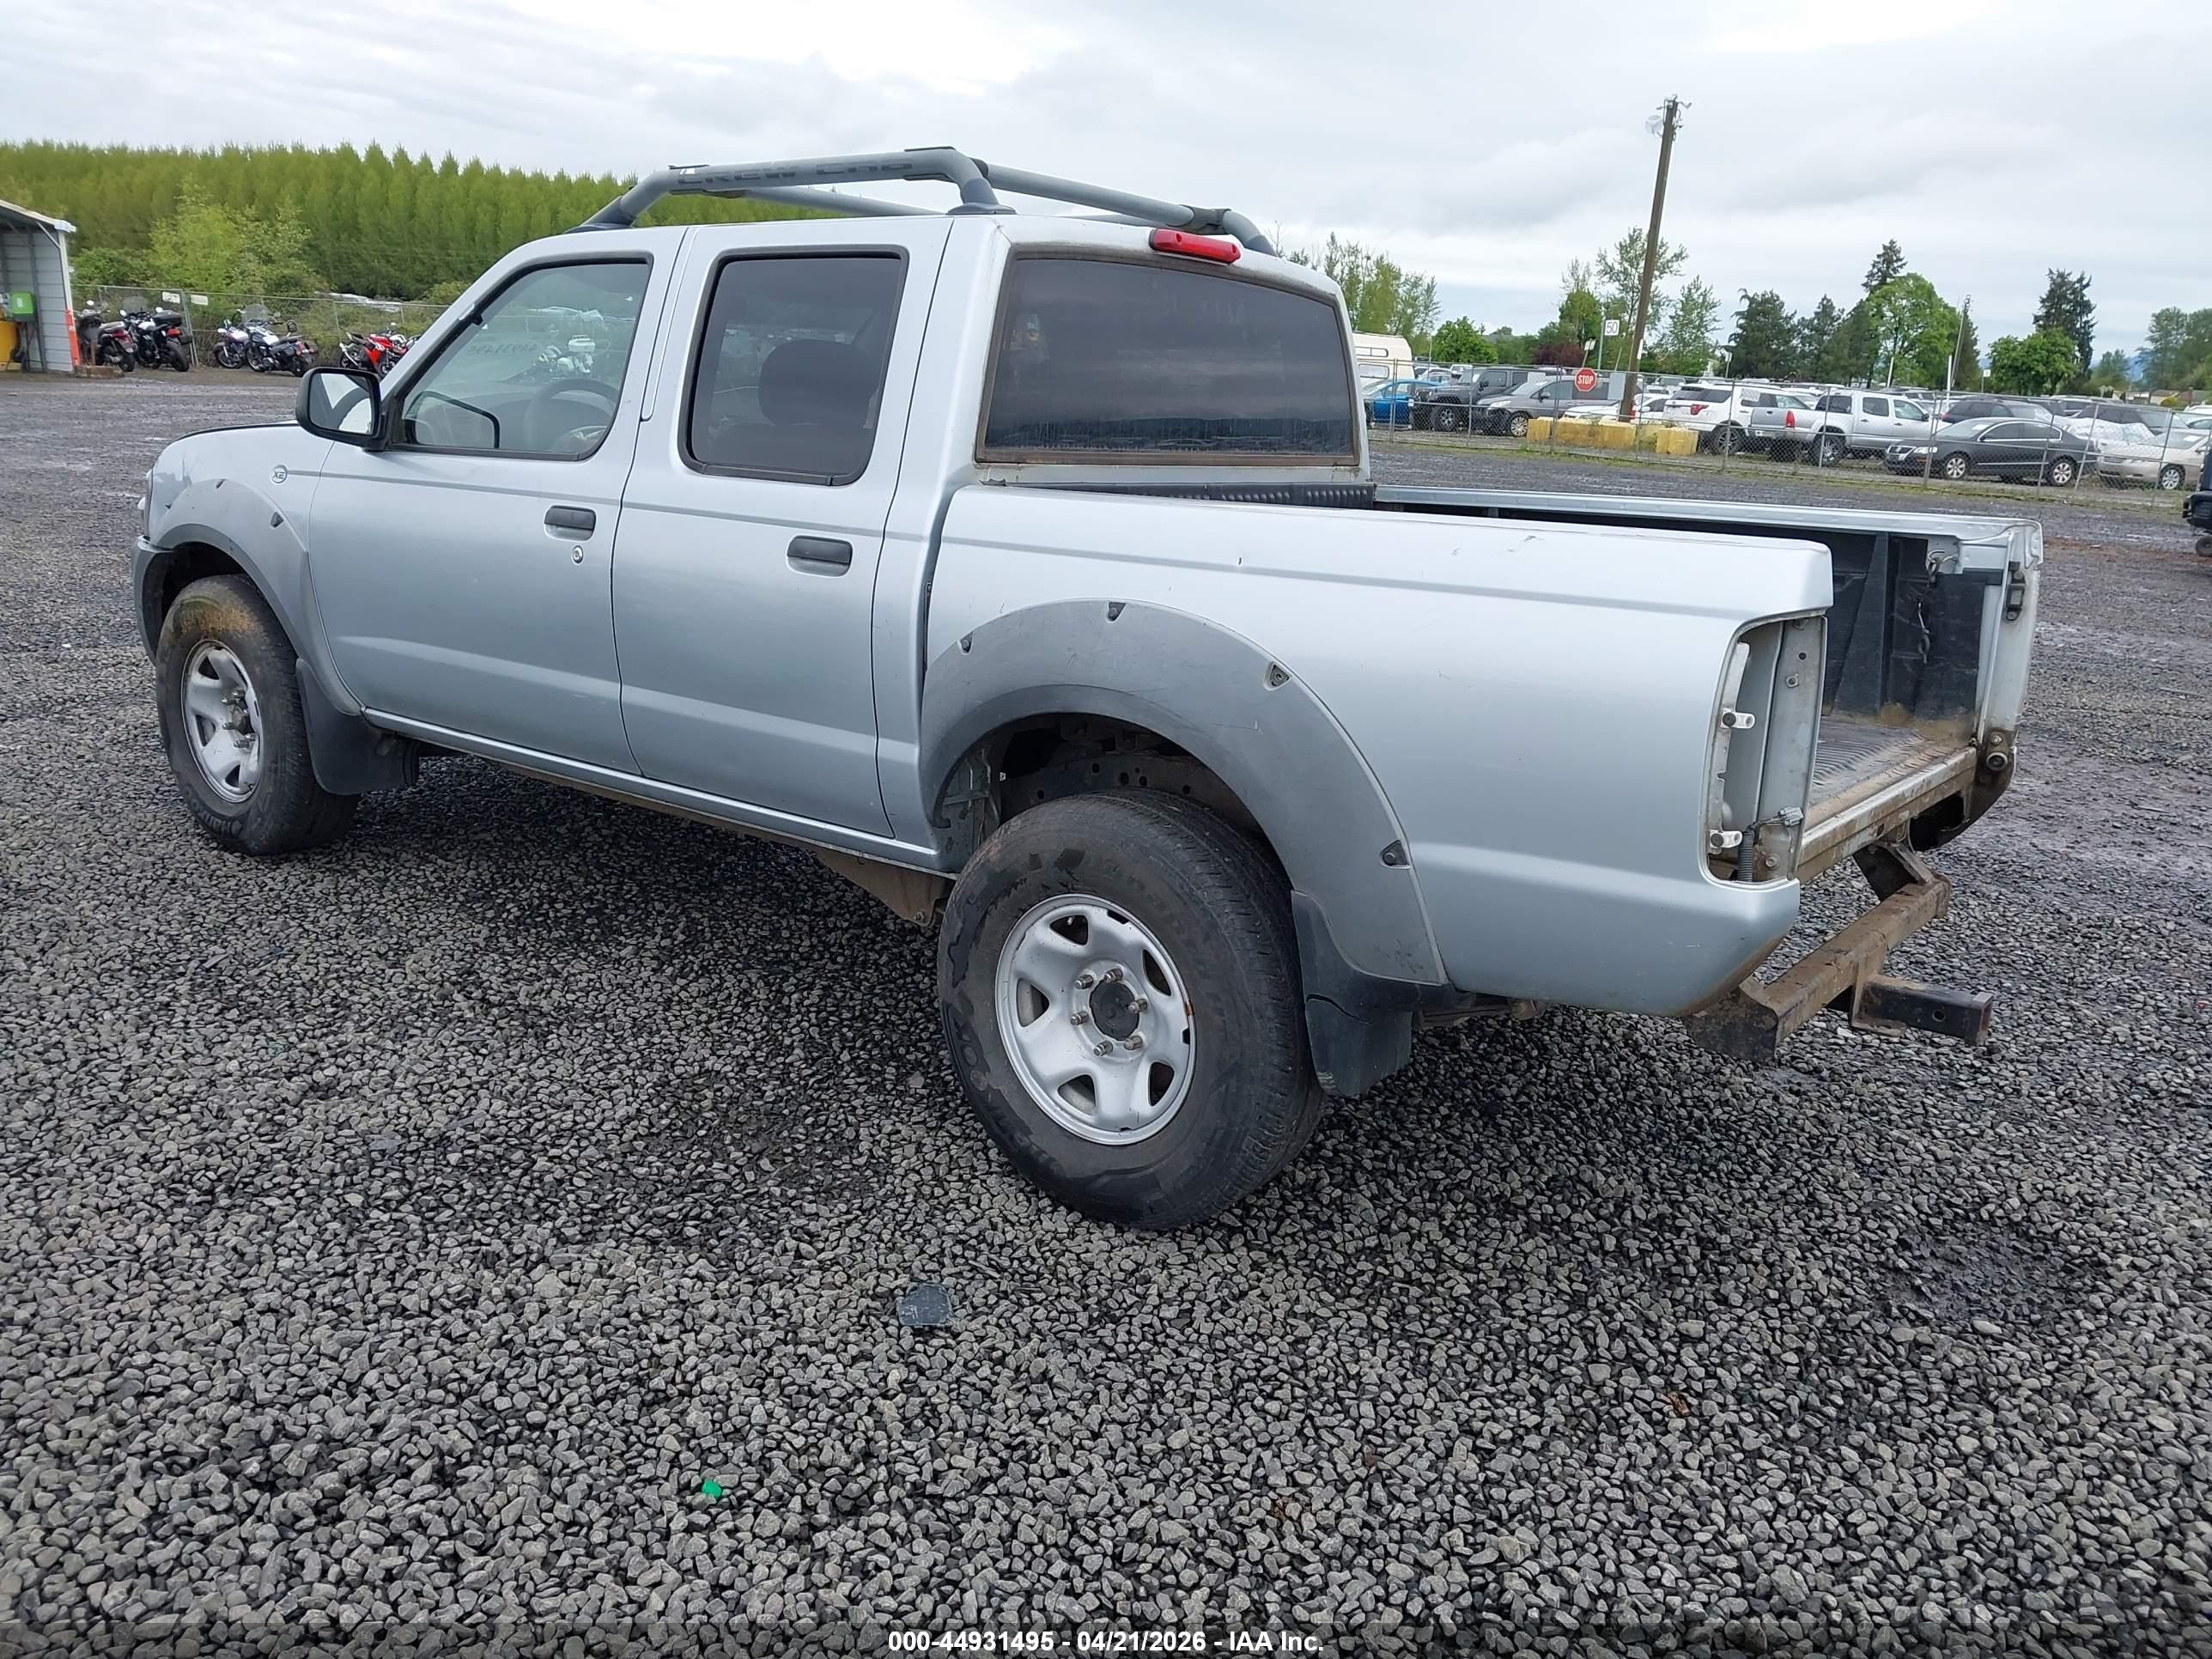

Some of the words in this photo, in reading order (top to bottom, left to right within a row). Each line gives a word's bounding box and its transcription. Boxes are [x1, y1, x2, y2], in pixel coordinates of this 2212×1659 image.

[1606, 321, 1619, 334] 50
[1577, 374, 1594, 385] STOP
[272, 470, 286, 480] XE
